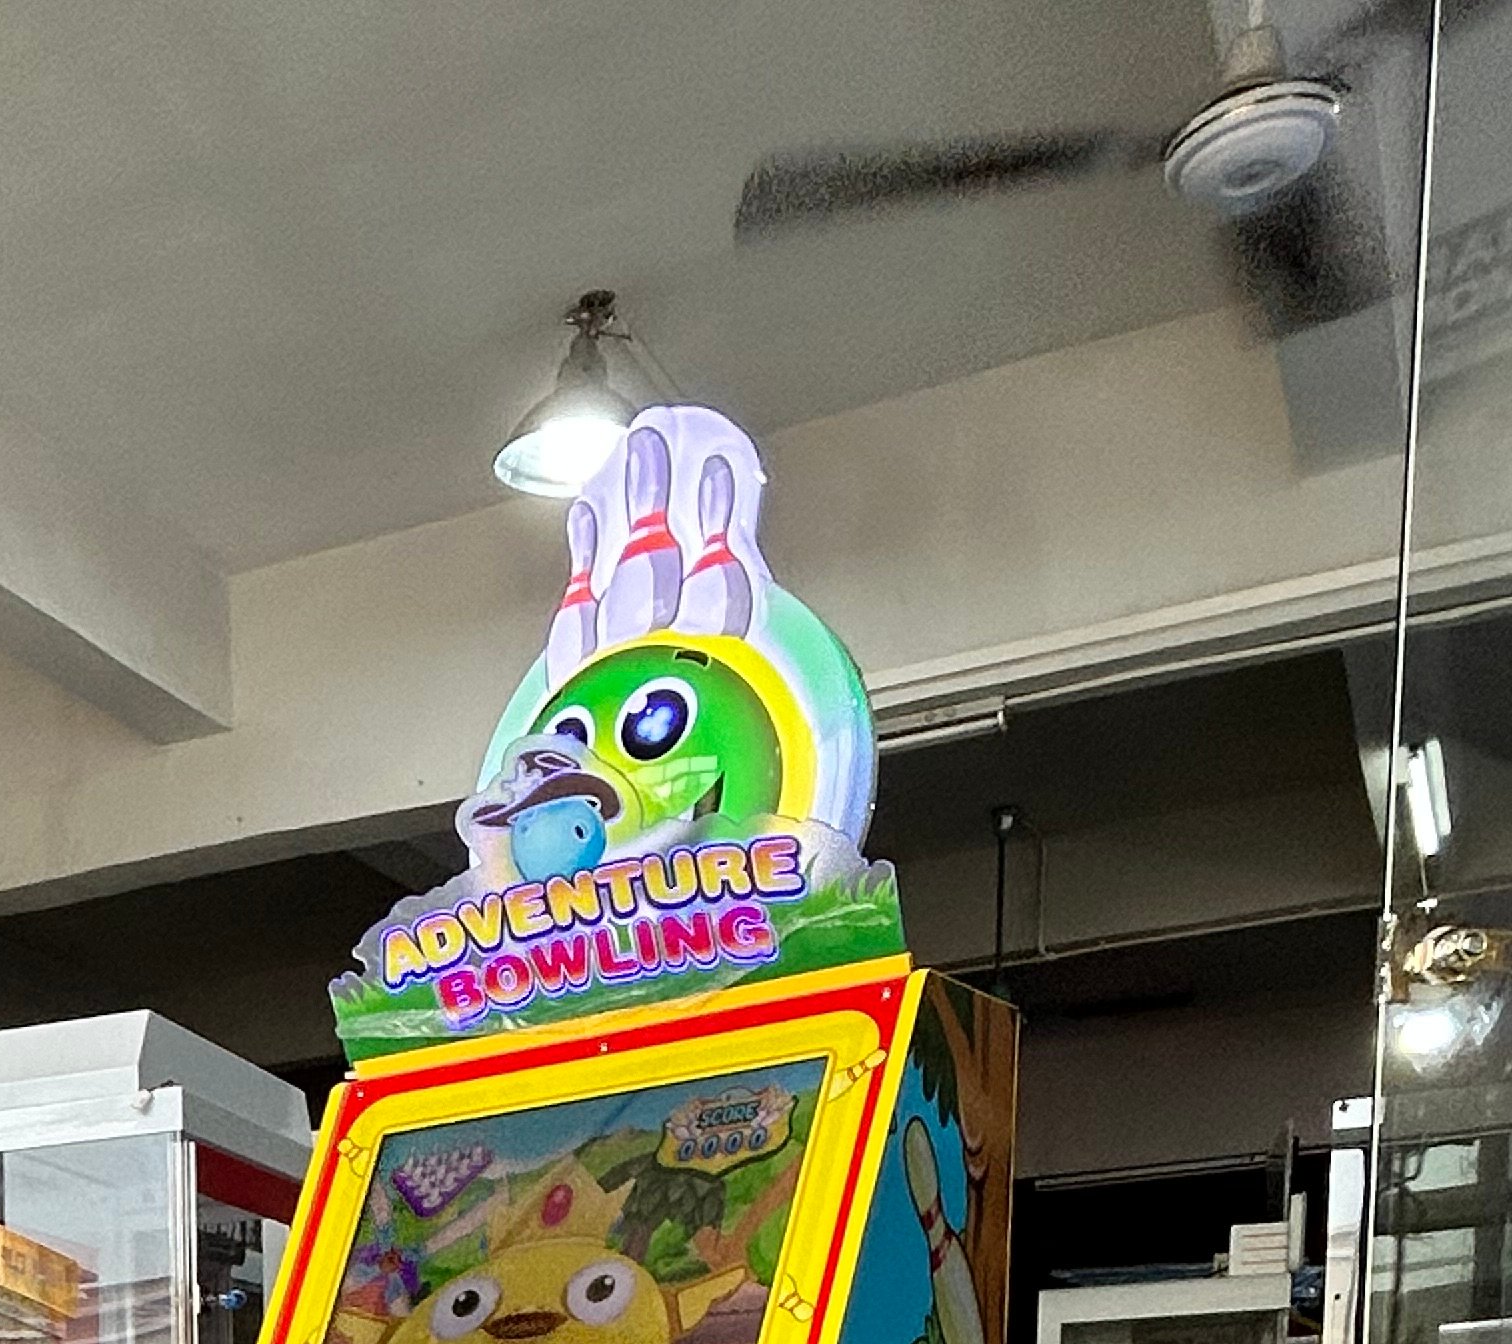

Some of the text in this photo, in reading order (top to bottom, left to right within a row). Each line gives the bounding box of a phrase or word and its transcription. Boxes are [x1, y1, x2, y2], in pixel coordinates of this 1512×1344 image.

[383, 836, 805, 988] ADVENTURE
[438, 905, 776, 1027] BOWLING
[698, 1101, 760, 1127] SCORE
